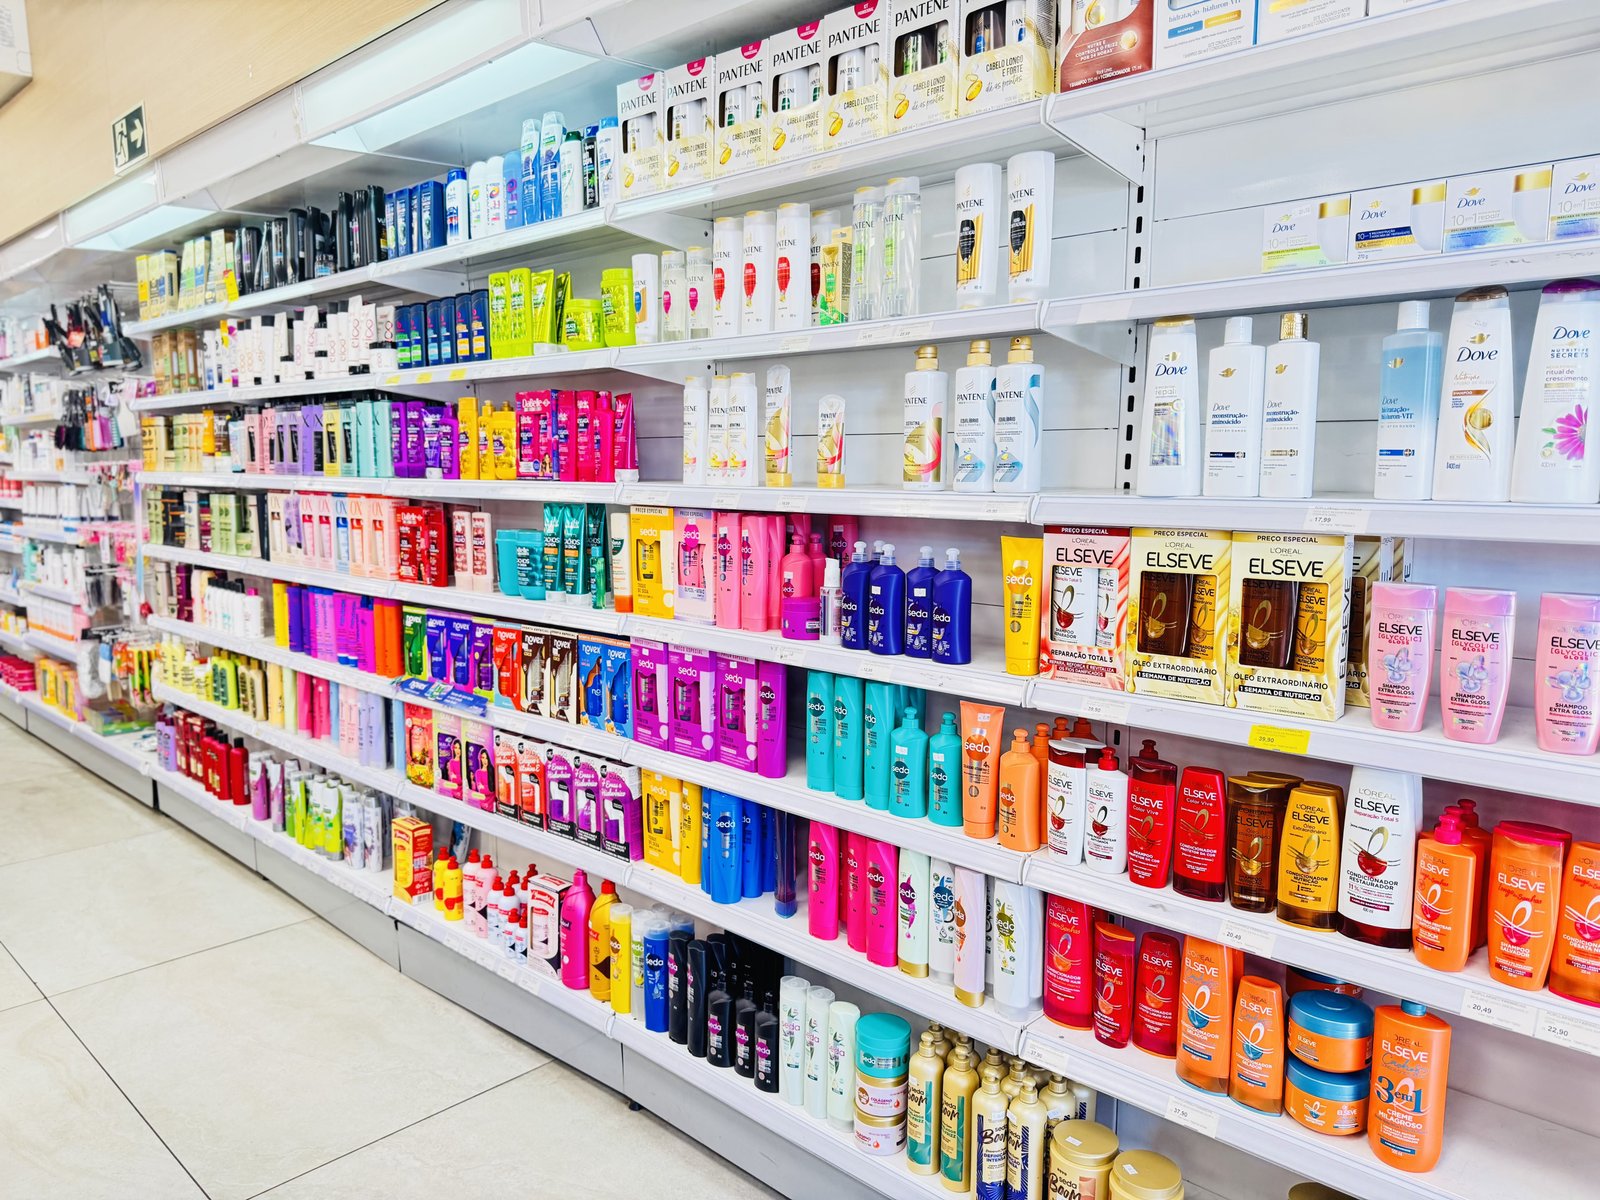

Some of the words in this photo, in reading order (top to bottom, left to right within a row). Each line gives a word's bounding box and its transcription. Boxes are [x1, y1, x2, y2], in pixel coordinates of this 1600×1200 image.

[895, 0, 949, 27] PANTENE
[828, 18, 881, 48] PANTENE
[772, 40, 821, 67] PANTENE
[986, 61, 1003, 73] CABELO
[1005, 54, 1023, 67] LONGO
[719, 59, 763, 84] PANTENE
[1007, 65, 1024, 75] FORTE
[667, 77, 708, 99] PANTENE
[913, 81, 928, 92] CABELO
[930, 76, 945, 88] LONGO
[931, 85, 945, 94] FORTE
[621, 91, 657, 113] PANTENE
[843, 100, 860, 110] CABELO
[861, 97, 874, 107] LONGO
[1564, 181, 1597, 195] Dove
[1457, 198, 1485, 208] Dove
[1361, 210, 1387, 220] Dove
[1272, 223, 1296, 233] Dove
[1552, 326, 1591, 340] Dove
[1456, 347, 1499, 363] Dove
[1154, 363, 1188, 377] Dove
[957, 393, 987, 401] PANTENE
[1382, 397, 1399, 405] Dove
[1213, 403, 1231, 412] Dove
[1267, 400, 1283, 409] Dove
[640, 527, 658, 537] seda
[683, 530, 700, 540] seda
[1061, 527, 1080, 535] PREÇO
[1257, 535, 1281, 543] PREÇO
[1056, 547, 1114, 565] ELSEVE
[1146, 552, 1213, 570] ELSEVE
[1249, 558, 1324, 577] ELSEVE
[1006, 574, 1033, 586] seda
[842, 601, 857, 611] seda
[869, 606, 885, 615] seda
[907, 608, 928, 618] seda
[933, 613, 951, 623] seda
[453, 621, 470, 631] novex
[1339, 578, 1350, 679] ELSEVE
[1378, 622, 1423, 636] ELSEVE
[497, 631, 517, 641] novex
[525, 635, 545, 645] novex
[1451, 629, 1500, 643] ELSEVE
[553, 639, 571, 649] novex
[582, 643, 602, 654] novex
[607, 649, 627, 660] novex
[1051, 649, 1086, 661] REPARAÇÃO
[1088, 654, 1108, 662] TOTAL
[638, 659, 654, 670] seda
[1133, 659, 1151, 668] ÓLEO
[1152, 661, 1218, 676] EXTRAORDINÁRIO
[678, 667, 697, 677] seda
[725, 673, 743, 685] seda
[1141, 672, 1166, 681] SEMANA
[1176, 676, 1210, 686] NUTRIÇÃO
[1234, 673, 1255, 682] ÓLEO
[1257, 675, 1328, 690] EXTRAORDINÁRIO
[1378, 687, 1395, 695] EXTRA
[1382, 683, 1410, 691] SHAMPOO
[760, 690, 776, 700] seda
[1244, 686, 1270, 696] SEMANA
[1284, 691, 1321, 701] NUTRIÇÃO
[1455, 692, 1486, 700] SHAMPOO
[1450, 696, 1469, 704] EXTRA
[808, 701, 825, 712] seda
[965, 741, 991, 755] seda
[892, 765, 910, 775] seda
[931, 772, 948, 782] seda
[1089, 787, 1114, 799] ELSEVE
[1183, 788, 1217, 800] ELSEVE
[1131, 793, 1164, 810] ELSEVE
[1354, 797, 1399, 816] ELSEVE
[1133, 805, 1146, 813] Color
[1353, 810, 1380, 820] Reparação
[715, 820, 736, 829] seda
[1236, 816, 1274, 828] ELSEVE
[1292, 811, 1329, 826] ELSEVE
[1292, 825, 1327, 835] Extraordinário
[1179, 842, 1217, 854] CONDICIONADOR
[1419, 860, 1450, 877] ELSEVE
[867, 872, 885, 883] seda
[1285, 869, 1328, 882] CONDICIONADOR
[1293, 875, 1318, 885] NUTRIÇÃO
[1346, 869, 1399, 886] CONDICIONADOR
[1348, 876, 1394, 891] RESTAURADOR
[1498, 872, 1546, 893] ELSEVE
[1049, 909, 1079, 926] ELSEVE
[1500, 942, 1530, 954] SHAMPOO
[1500, 946, 1530, 958] SALVADOR
[645, 956, 664, 966] seda
[1143, 953, 1173, 968] ELSEVE
[1095, 958, 1123, 977] ELSEVE
[1185, 957, 1219, 977] ELSEVE
[1240, 999, 1273, 1016] ELSEVE
[1472, 1003, 1492, 1015] 20,49
[1547, 1025, 1569, 1037] 22,90
[1297, 1035, 1317, 1048] ELSEVE
[1382, 1040, 1429, 1063] ELSEVE
[1378, 1110, 1423, 1130] MILAGROSO
[1386, 1109, 1413, 1122] CREME
[1059, 1176, 1077, 1189] seda
